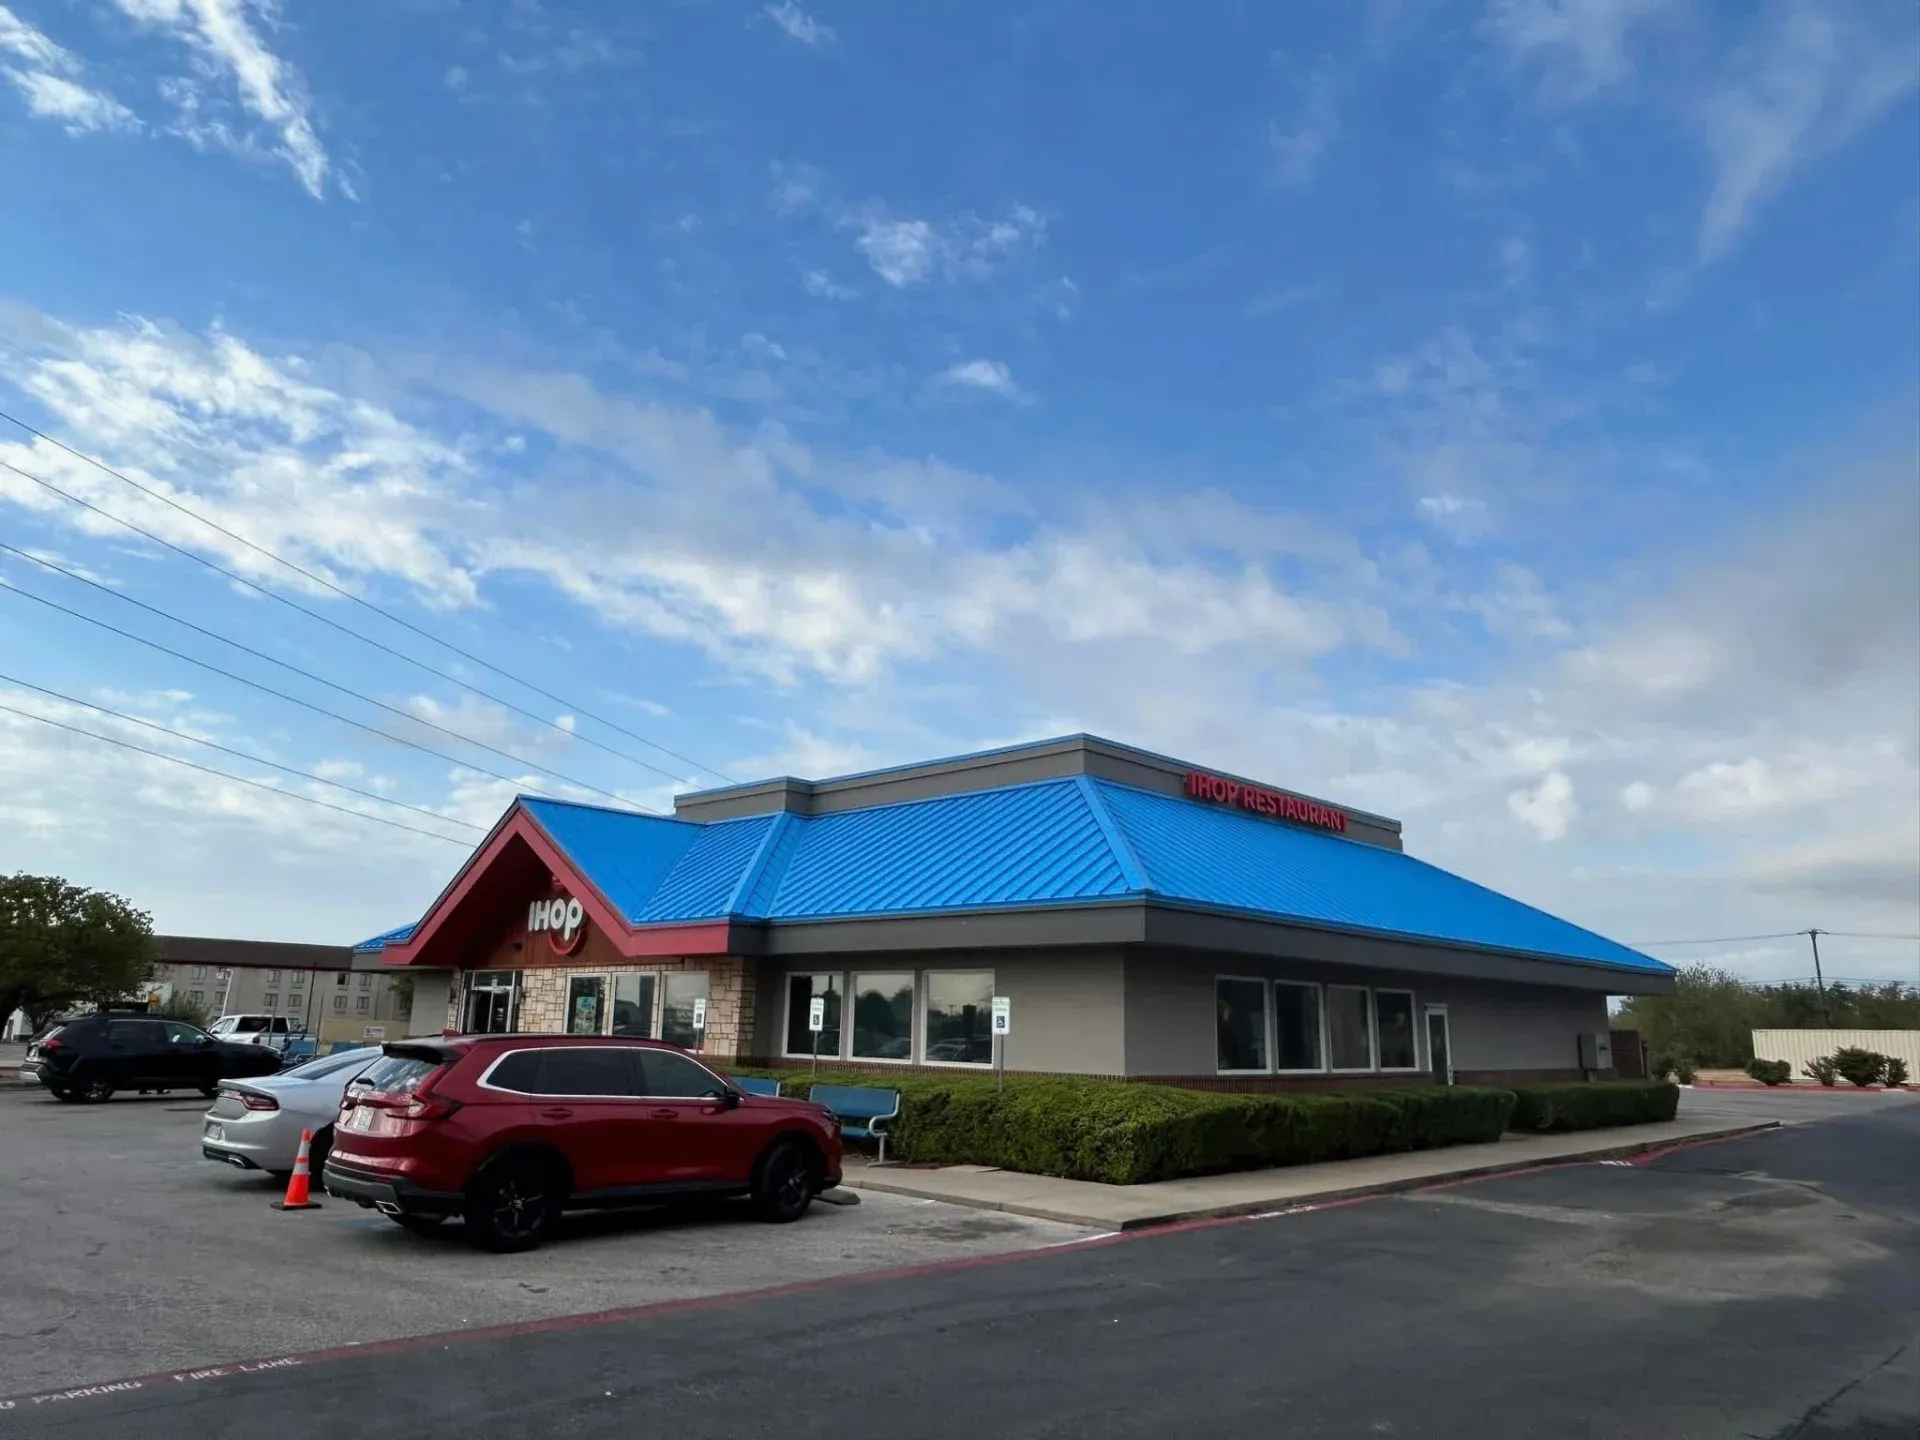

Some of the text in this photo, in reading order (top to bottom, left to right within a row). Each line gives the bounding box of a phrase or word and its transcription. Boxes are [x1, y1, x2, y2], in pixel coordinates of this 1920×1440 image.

[1188, 772, 1238, 803] IHOP
[528, 897, 583, 940] IHOP
[32, 1380, 142, 1403] PARKING
[173, 1367, 229, 1381] FIRE
[239, 1357, 301, 1371] LANE
